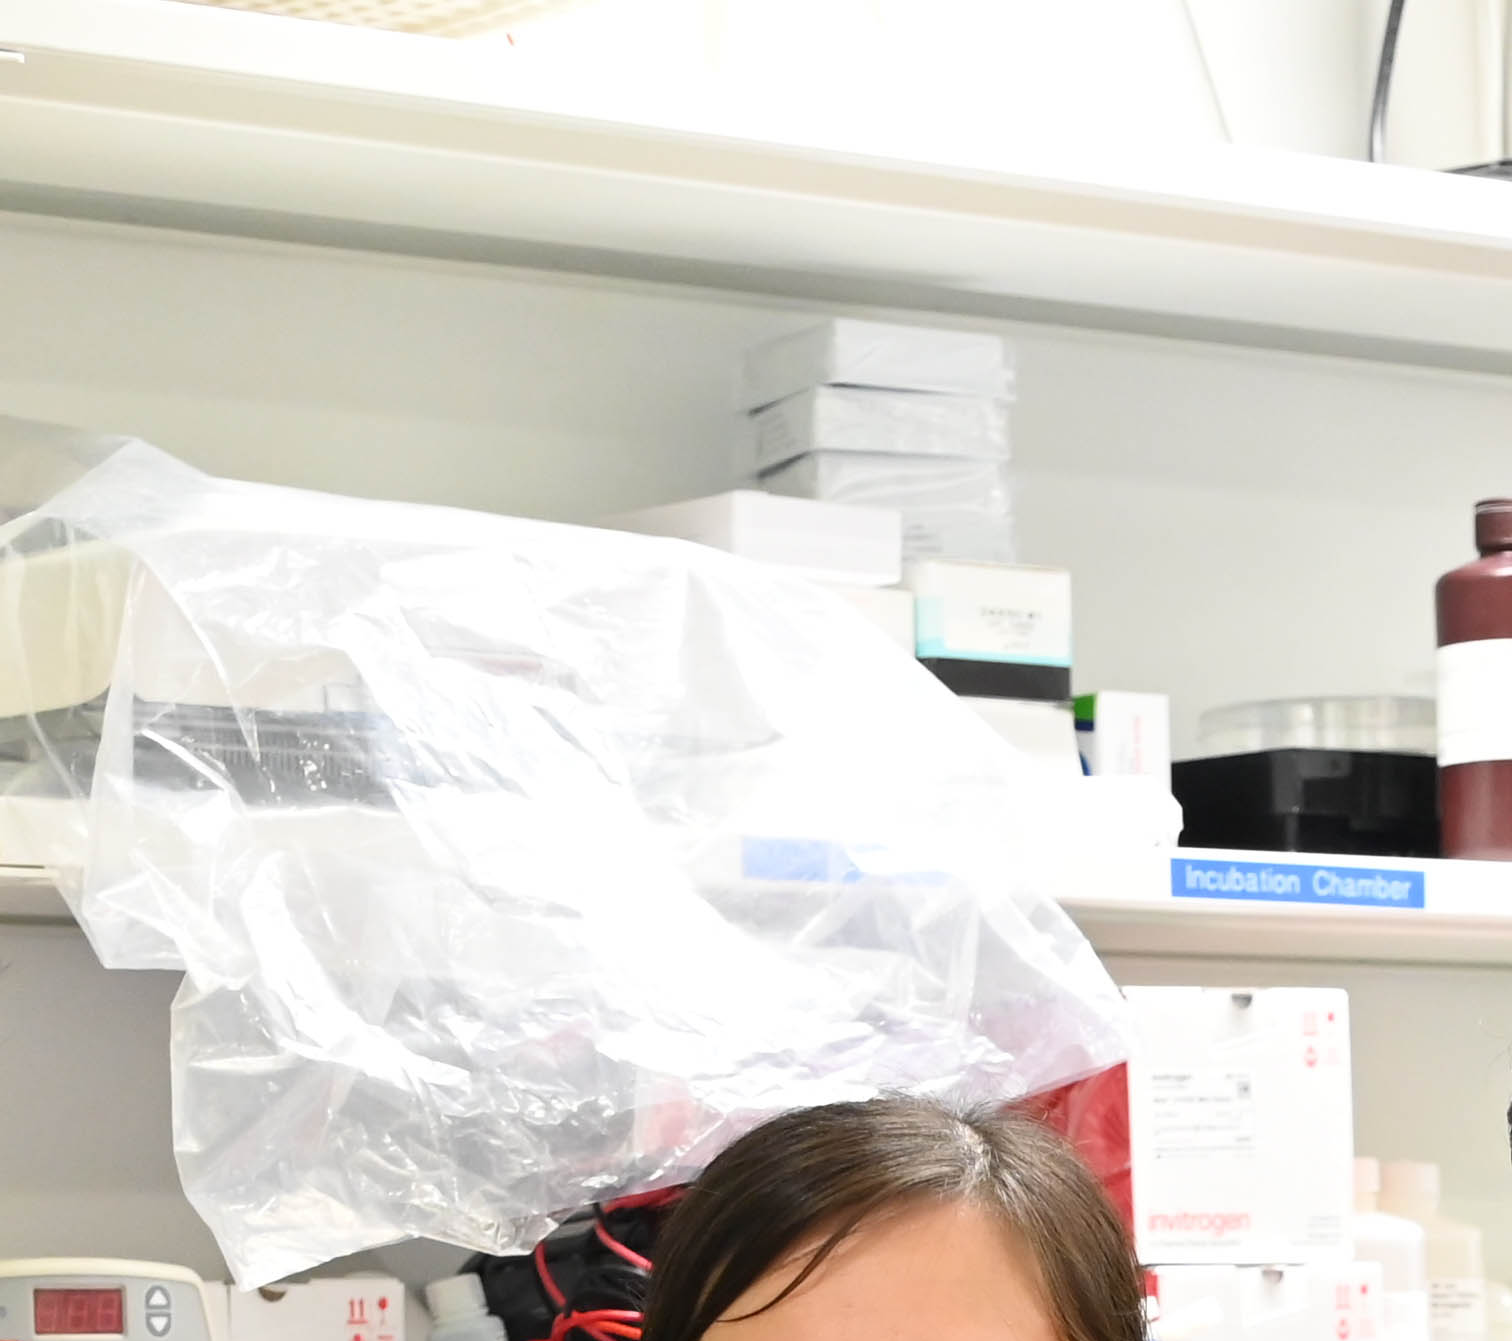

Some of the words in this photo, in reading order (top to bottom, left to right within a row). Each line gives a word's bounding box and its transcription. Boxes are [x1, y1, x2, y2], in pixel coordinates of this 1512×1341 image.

[1185, 865, 1300, 895] Incubation
[1313, 870, 1412, 900] Chamber
[1148, 1209, 1252, 1238] invitrogen
